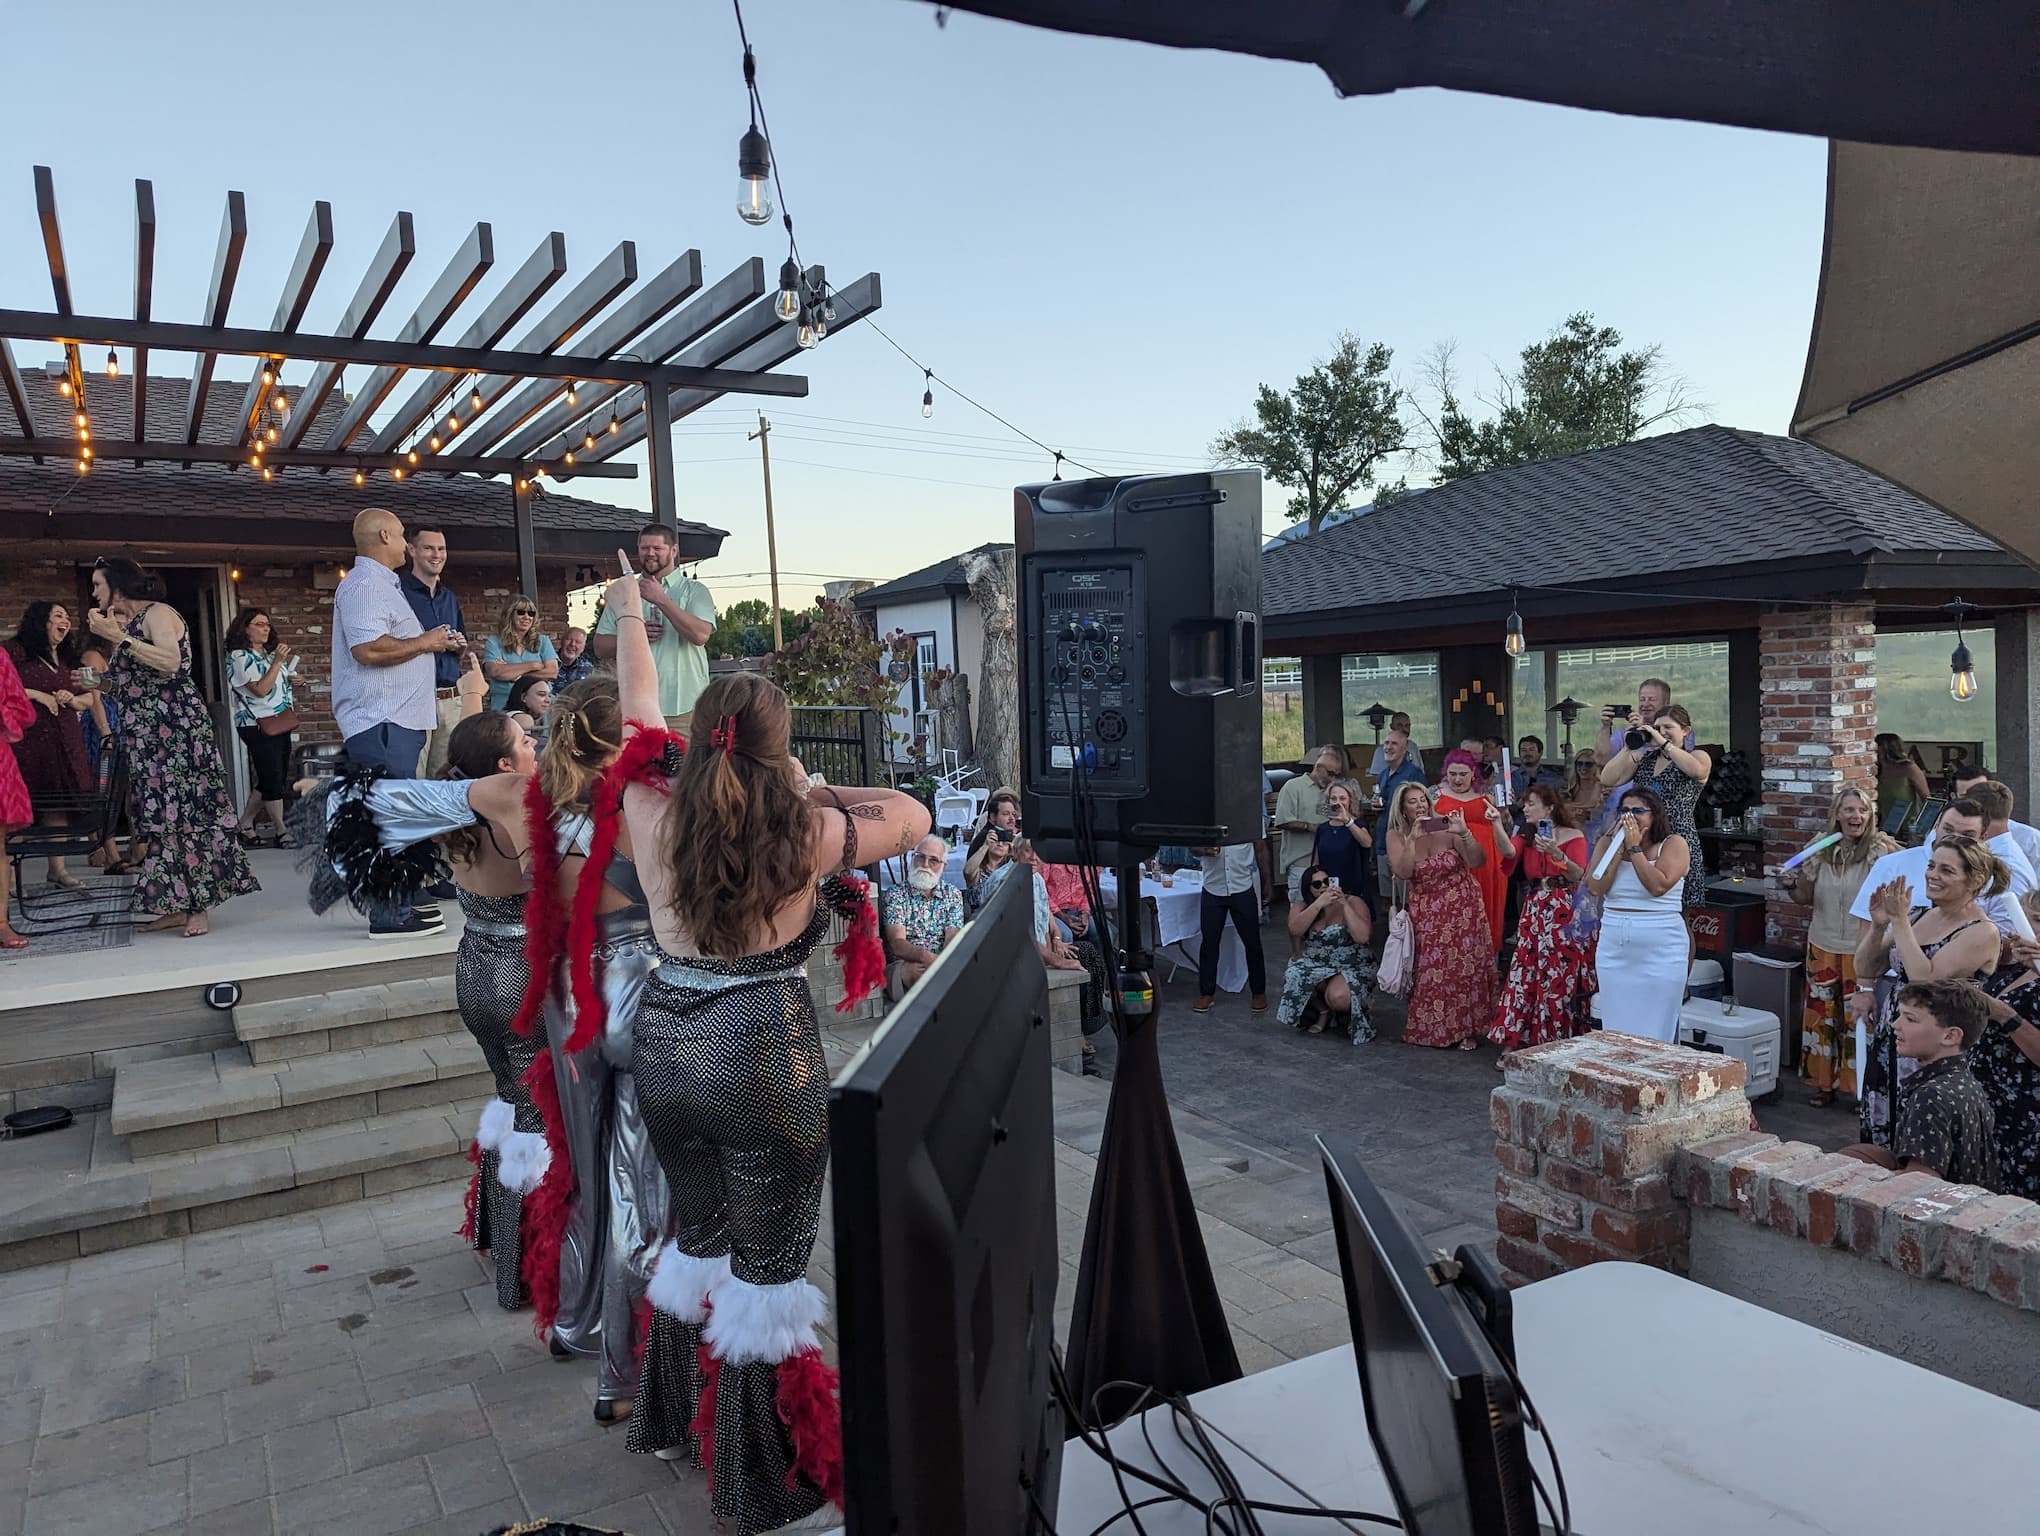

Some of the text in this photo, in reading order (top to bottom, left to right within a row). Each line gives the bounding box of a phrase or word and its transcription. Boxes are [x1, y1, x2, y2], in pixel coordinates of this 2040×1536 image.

[1072, 574, 1101, 582] QSC
[1907, 744, 1968, 774] AR
[1692, 915, 1720, 936] Cola
